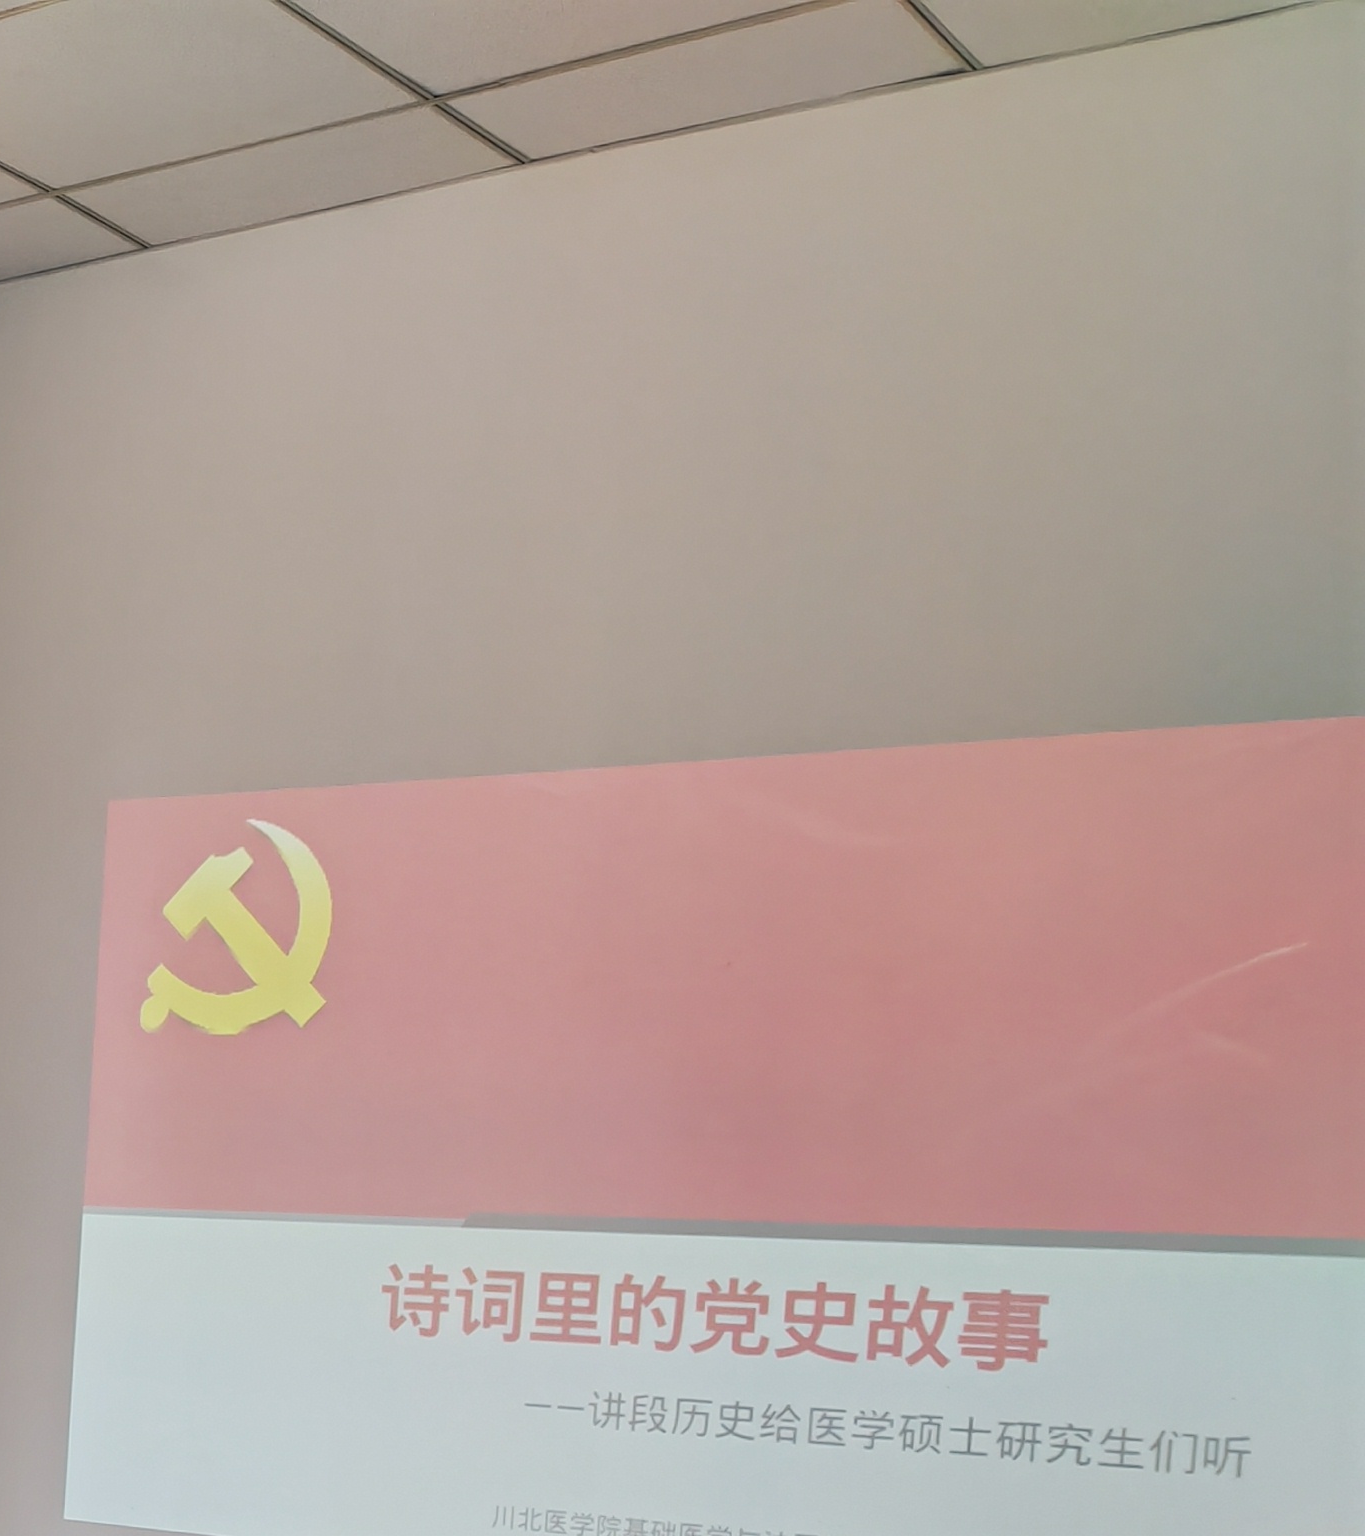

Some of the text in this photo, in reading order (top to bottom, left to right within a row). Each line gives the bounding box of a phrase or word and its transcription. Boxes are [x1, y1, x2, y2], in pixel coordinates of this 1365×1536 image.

[380, 1262, 1050, 1372] 诗词里的党史故事
